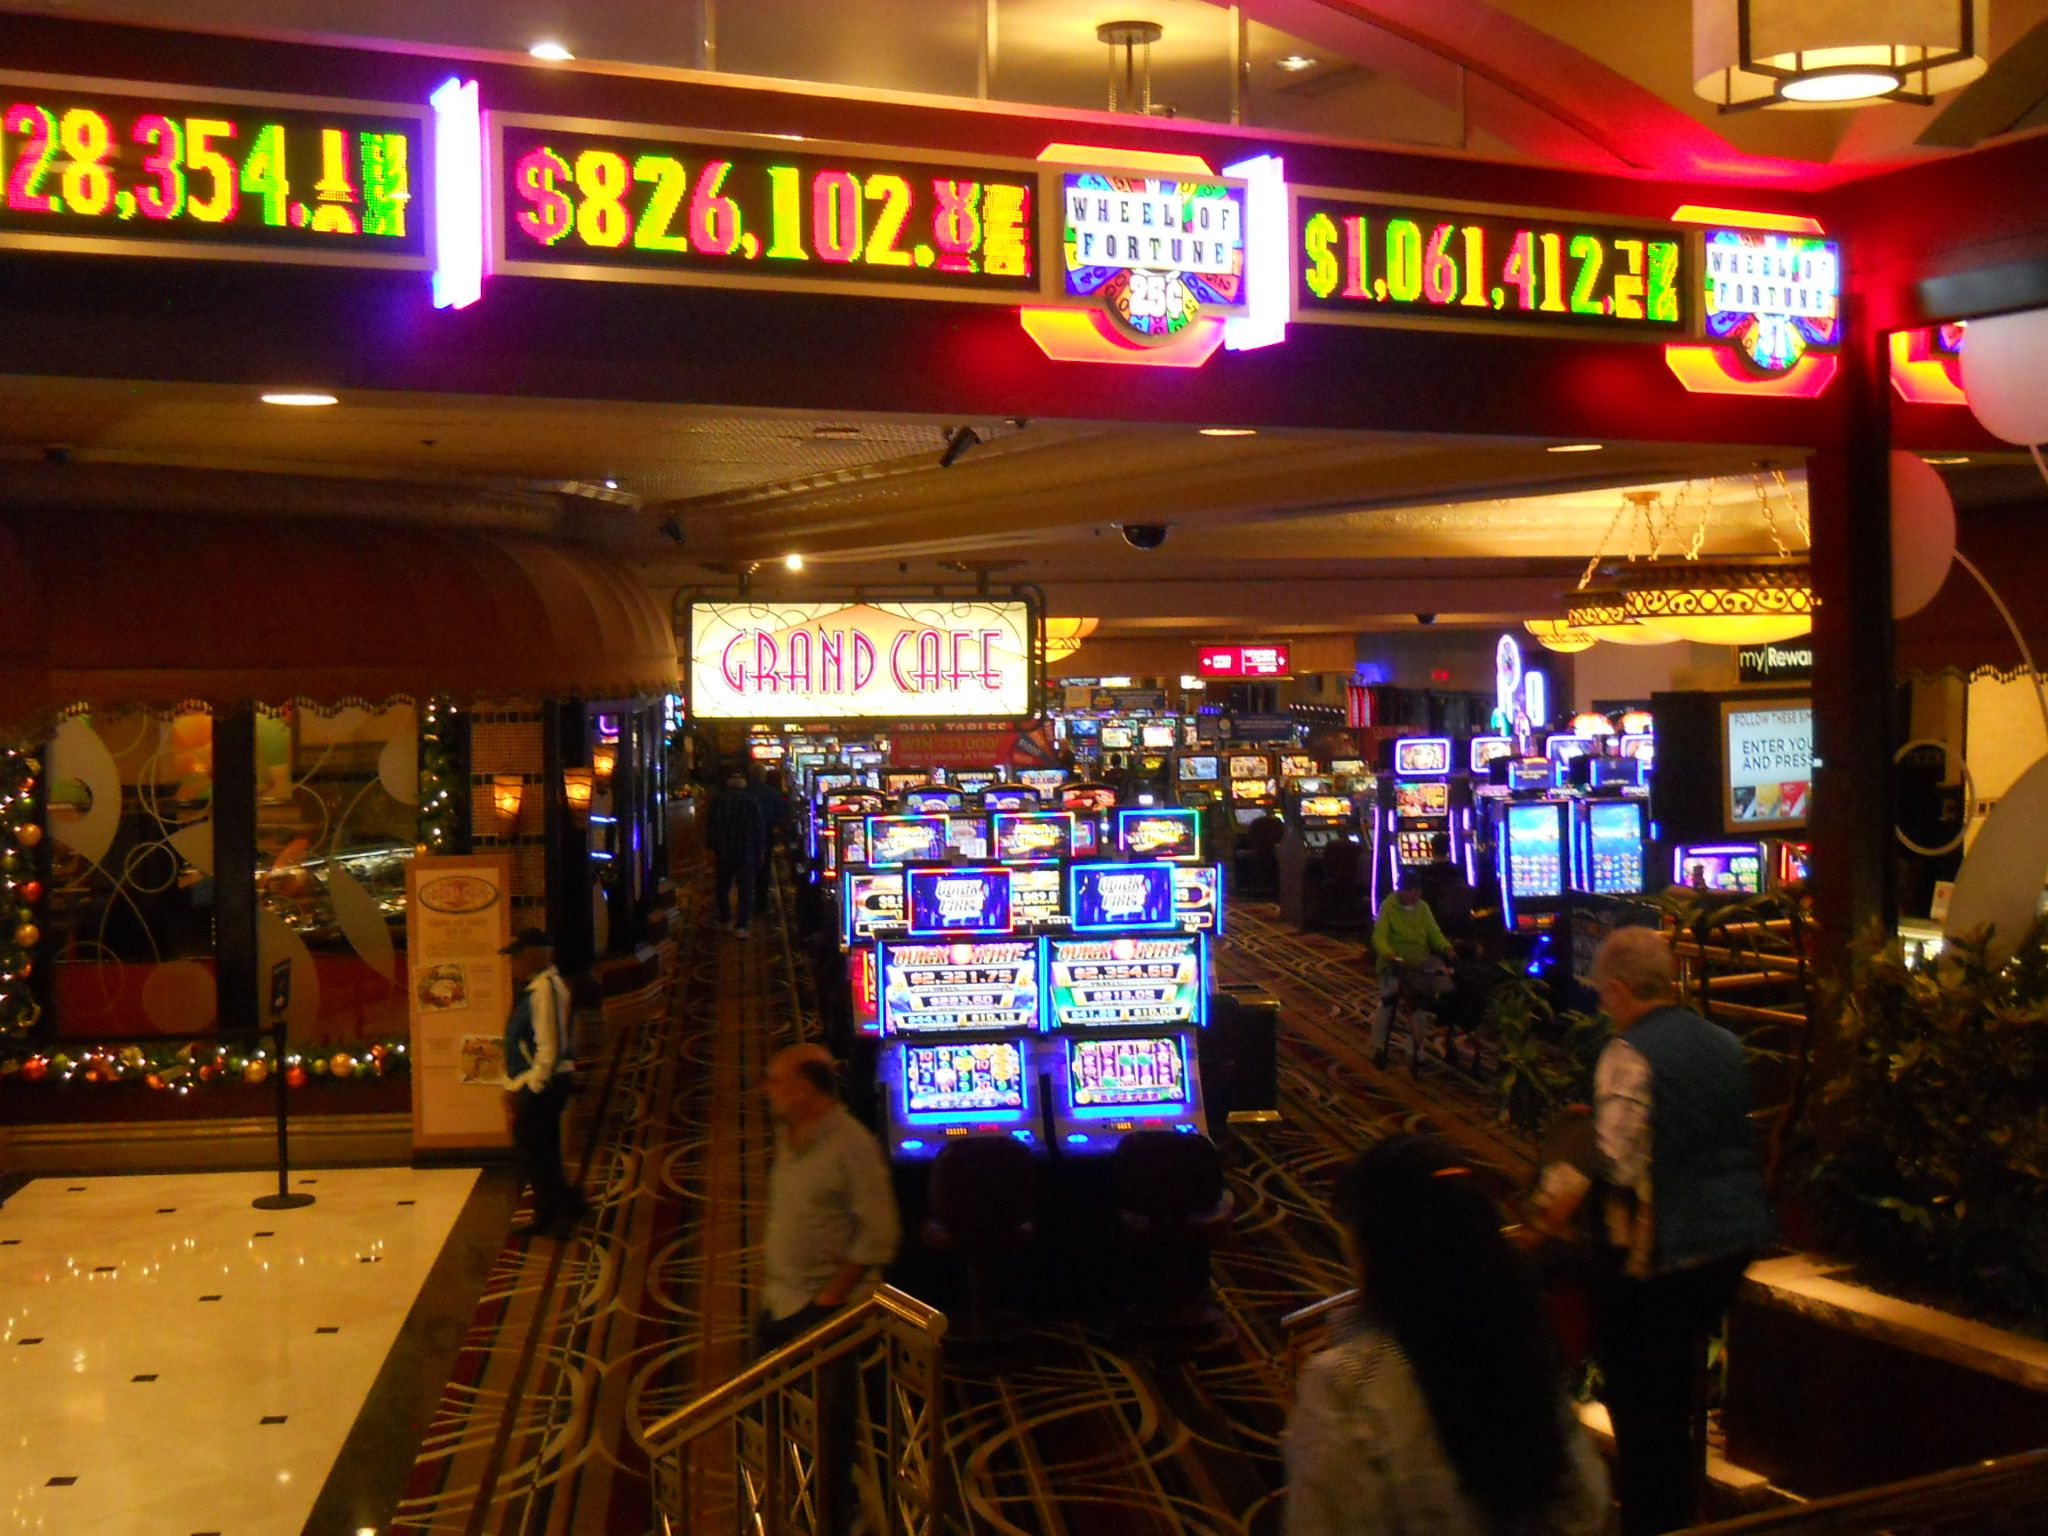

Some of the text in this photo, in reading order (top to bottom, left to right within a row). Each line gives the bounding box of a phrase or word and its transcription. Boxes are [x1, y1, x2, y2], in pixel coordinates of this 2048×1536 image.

[1073, 196, 1229, 230] WHEEL OF
[1084, 232, 1224, 265] FORTUNE
[1711, 251, 1787, 278] WHEEL
[1720, 282, 1823, 310] FORTUNE
[720, 625, 1003, 696] GRAND CAFE
[1734, 714, 1769, 727] FOLLOW
[1771, 712, 1798, 725] THESE
[1742, 738, 1786, 755] ENTER
[1742, 755, 1772, 771] AND
